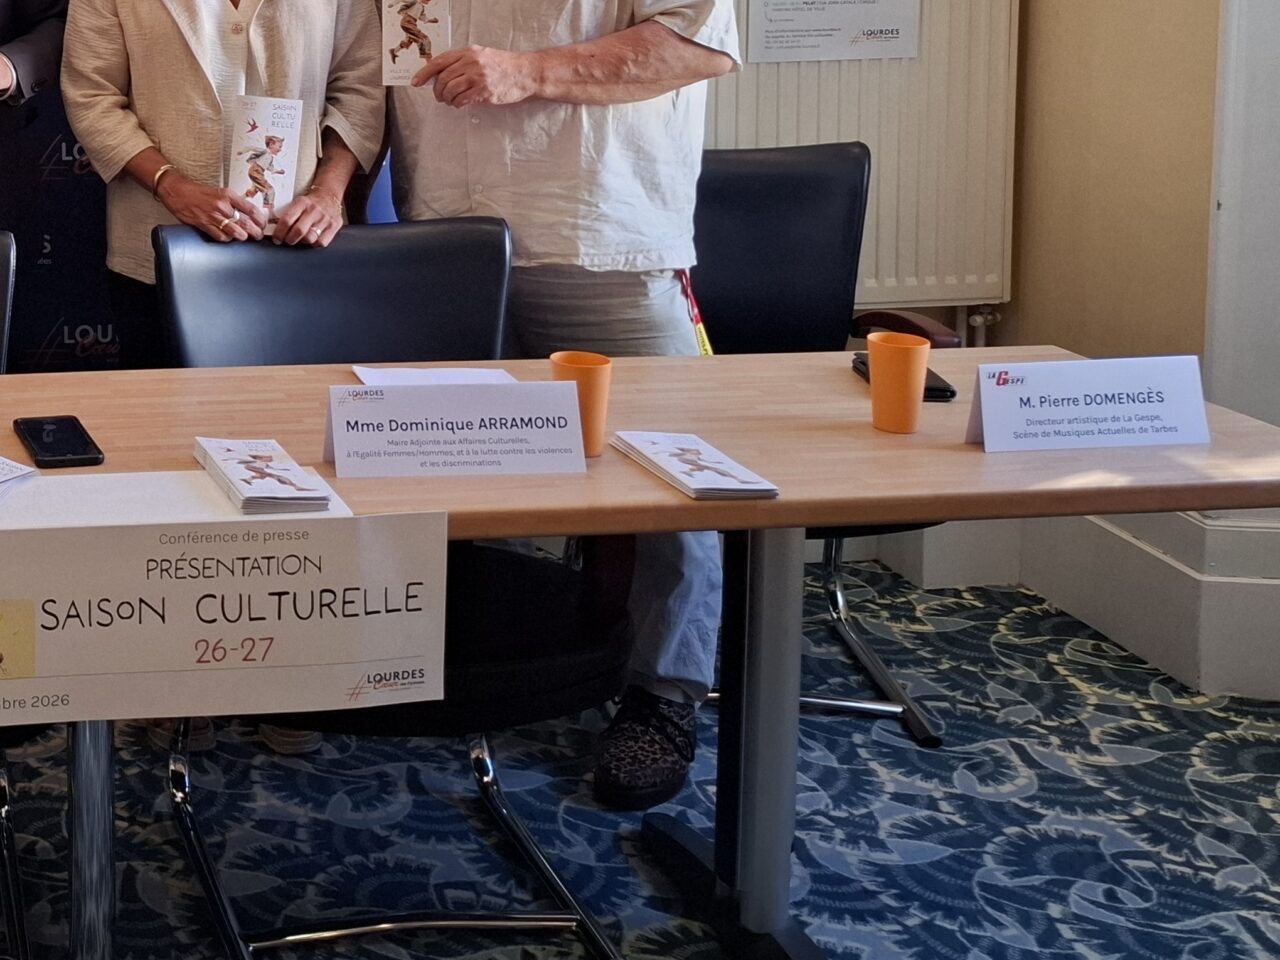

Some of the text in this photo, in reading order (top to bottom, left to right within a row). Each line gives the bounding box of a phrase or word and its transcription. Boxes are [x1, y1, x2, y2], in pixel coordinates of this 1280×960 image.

[862, 29, 900, 37] LOURDES
[348, 390, 384, 398] LOURDES
[1019, 387, 1165, 409] M. Pierre DOMENGÈS
[346, 416, 568, 435] Mme Dominique ARRAMOND
[1026, 416, 1065, 426] Directeur
[1067, 415, 1109, 426] artistique
[1110, 414, 1121, 423] de
[1123, 414, 1133, 423] La
[1012, 424, 1178, 440] Scène de Musiques Actuelles de Tarbes
[410, 438, 441, 448] Adjointe
[480, 448, 498, 456] lutte
[537, 446, 572, 454] violences
[158, 529, 310, 545] Conférence de presse
[145, 552, 324, 581] PRÉSENTATION
[39, 582, 424, 632] SAISON CULTURELLE
[194, 637, 275, 665] 26-27
[367, 668, 425, 684] LOURDES
[30, 693, 70, 708] 2026
